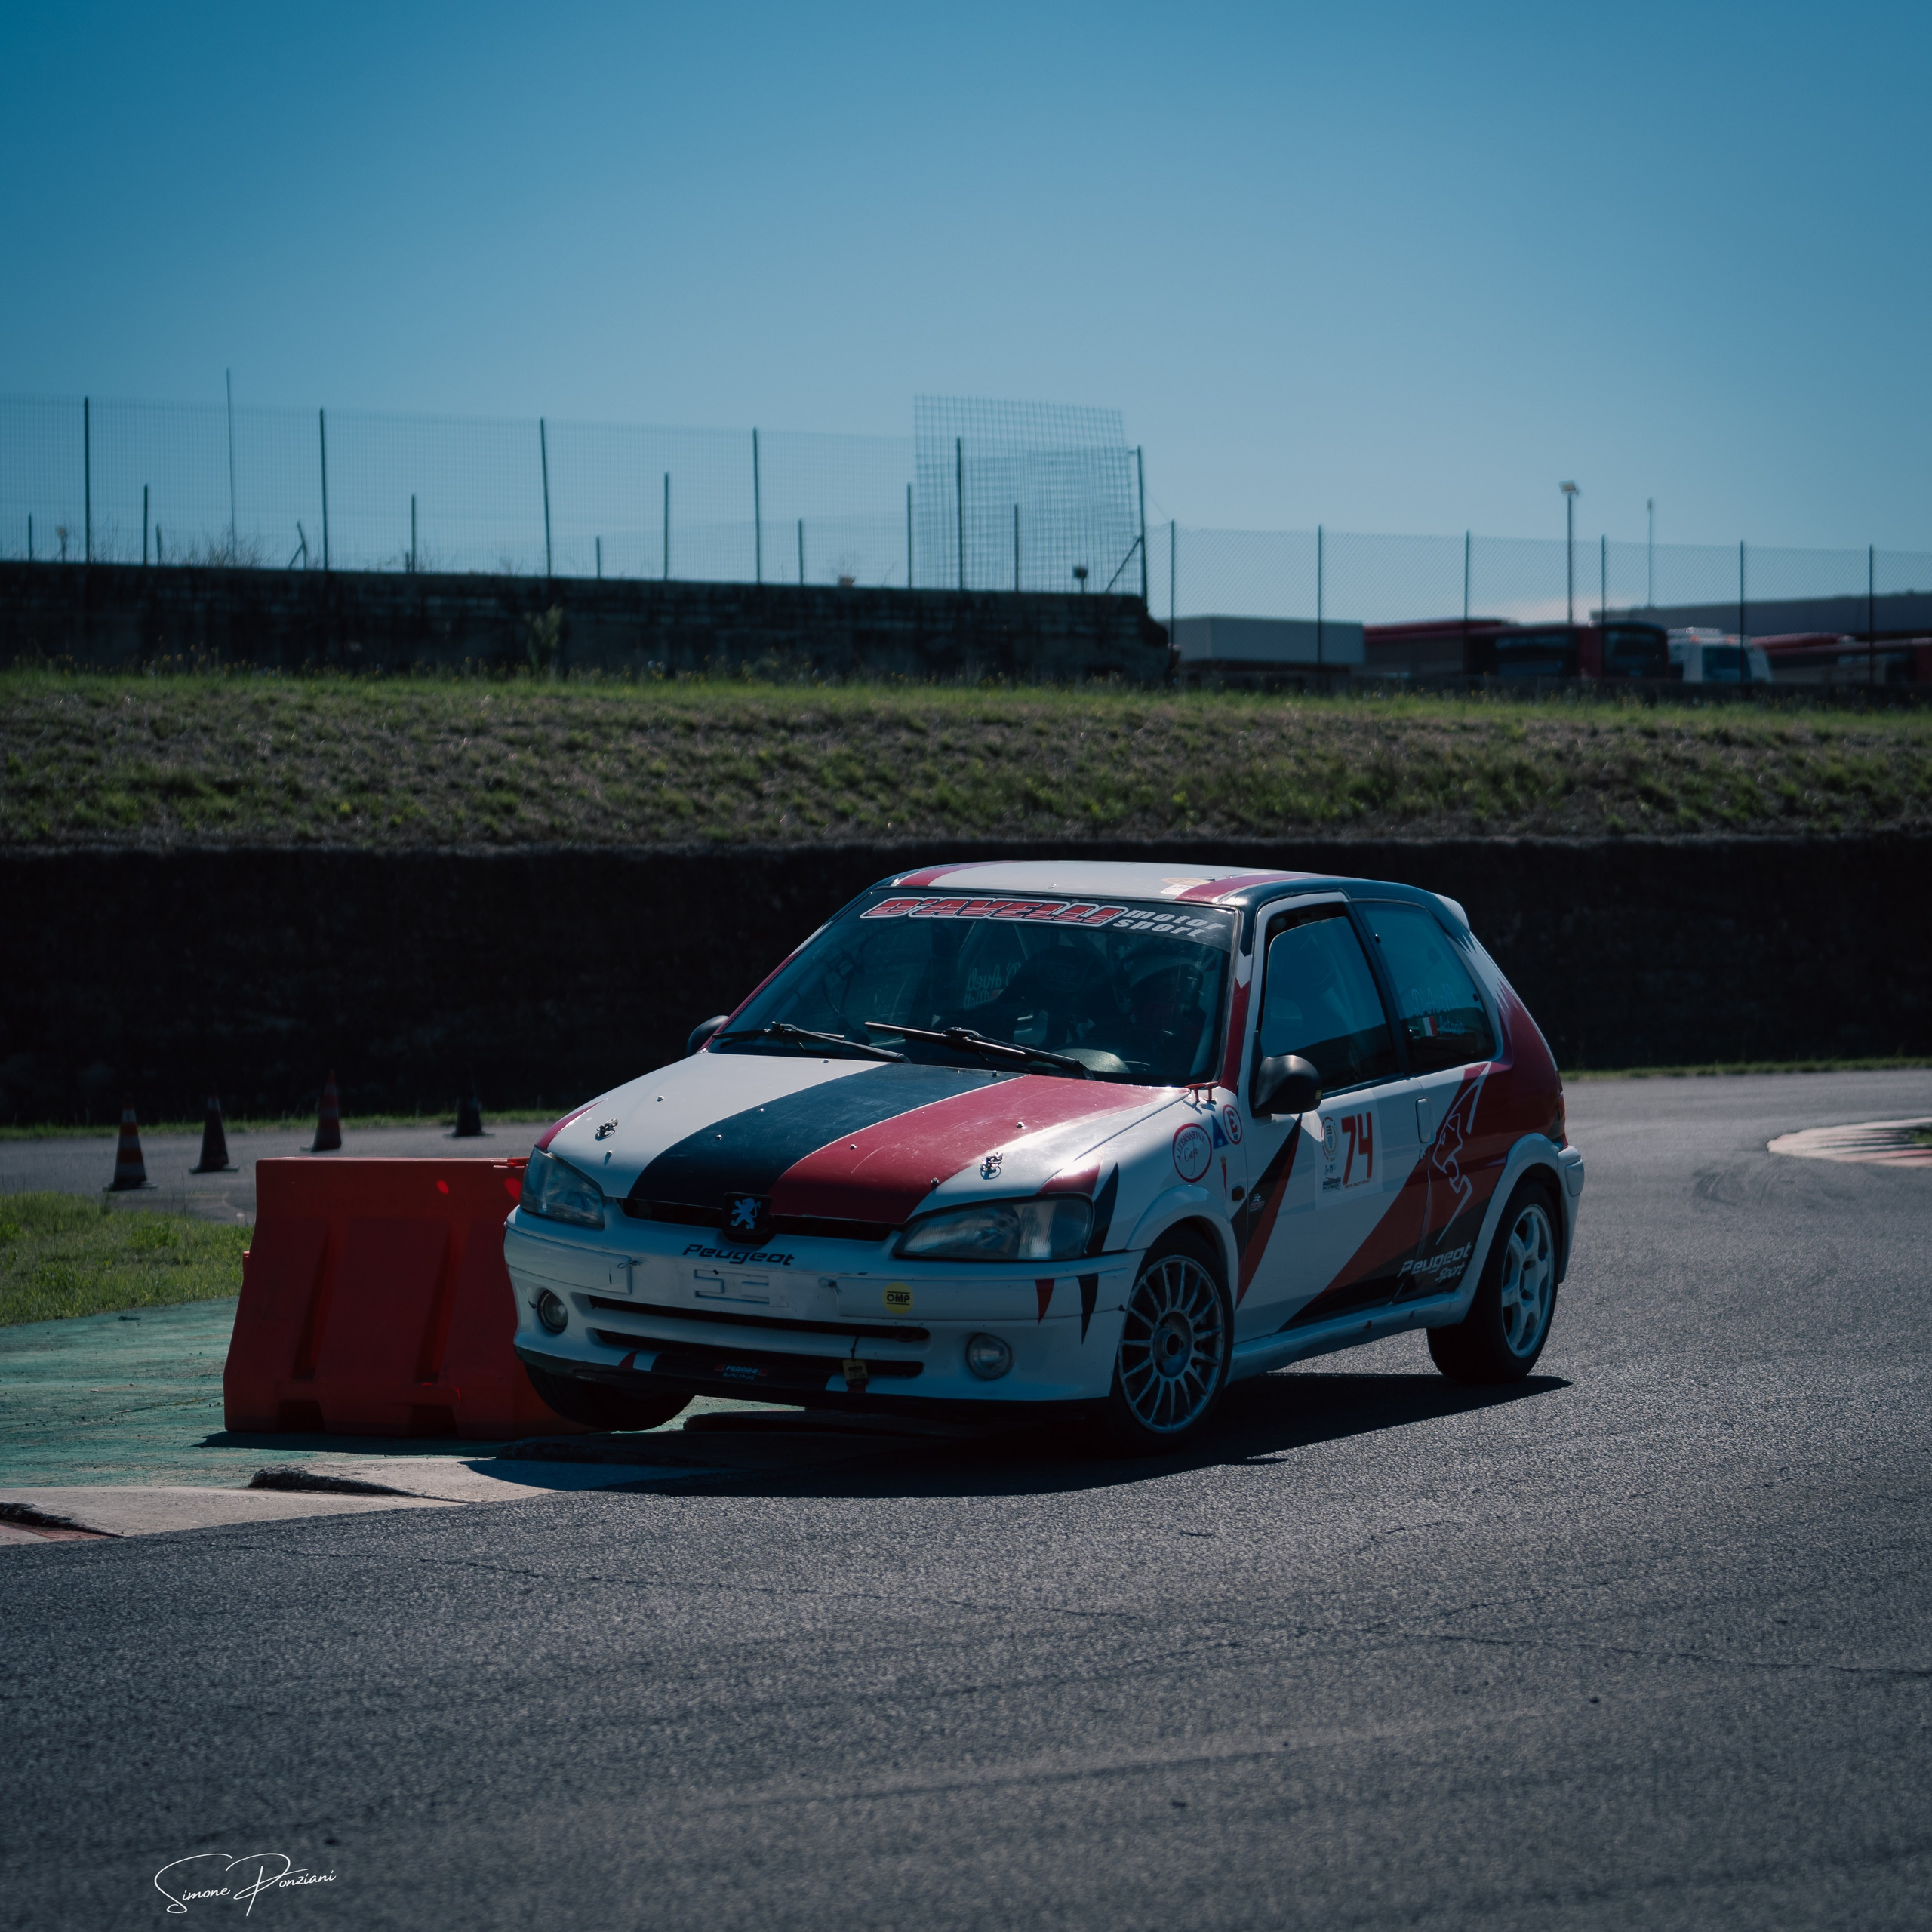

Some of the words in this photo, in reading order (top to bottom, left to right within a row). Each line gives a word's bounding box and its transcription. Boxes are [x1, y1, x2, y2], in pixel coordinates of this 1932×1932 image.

[860, 896, 1129, 926] D'AVELLI
[1123, 910, 1226, 929] motor
[1112, 919, 1206, 937] sport
[1177, 1131, 1205, 1162] ALTERNATIVE
[1341, 1111, 1373, 1186] 74
[682, 1244, 795, 1265] Peugeot
[1397, 1241, 1472, 1278] Peugeot
[887, 1294, 910, 1303] OMP
[723, 1371, 755, 1380] RACING
[725, 1365, 758, 1374] FERODO
